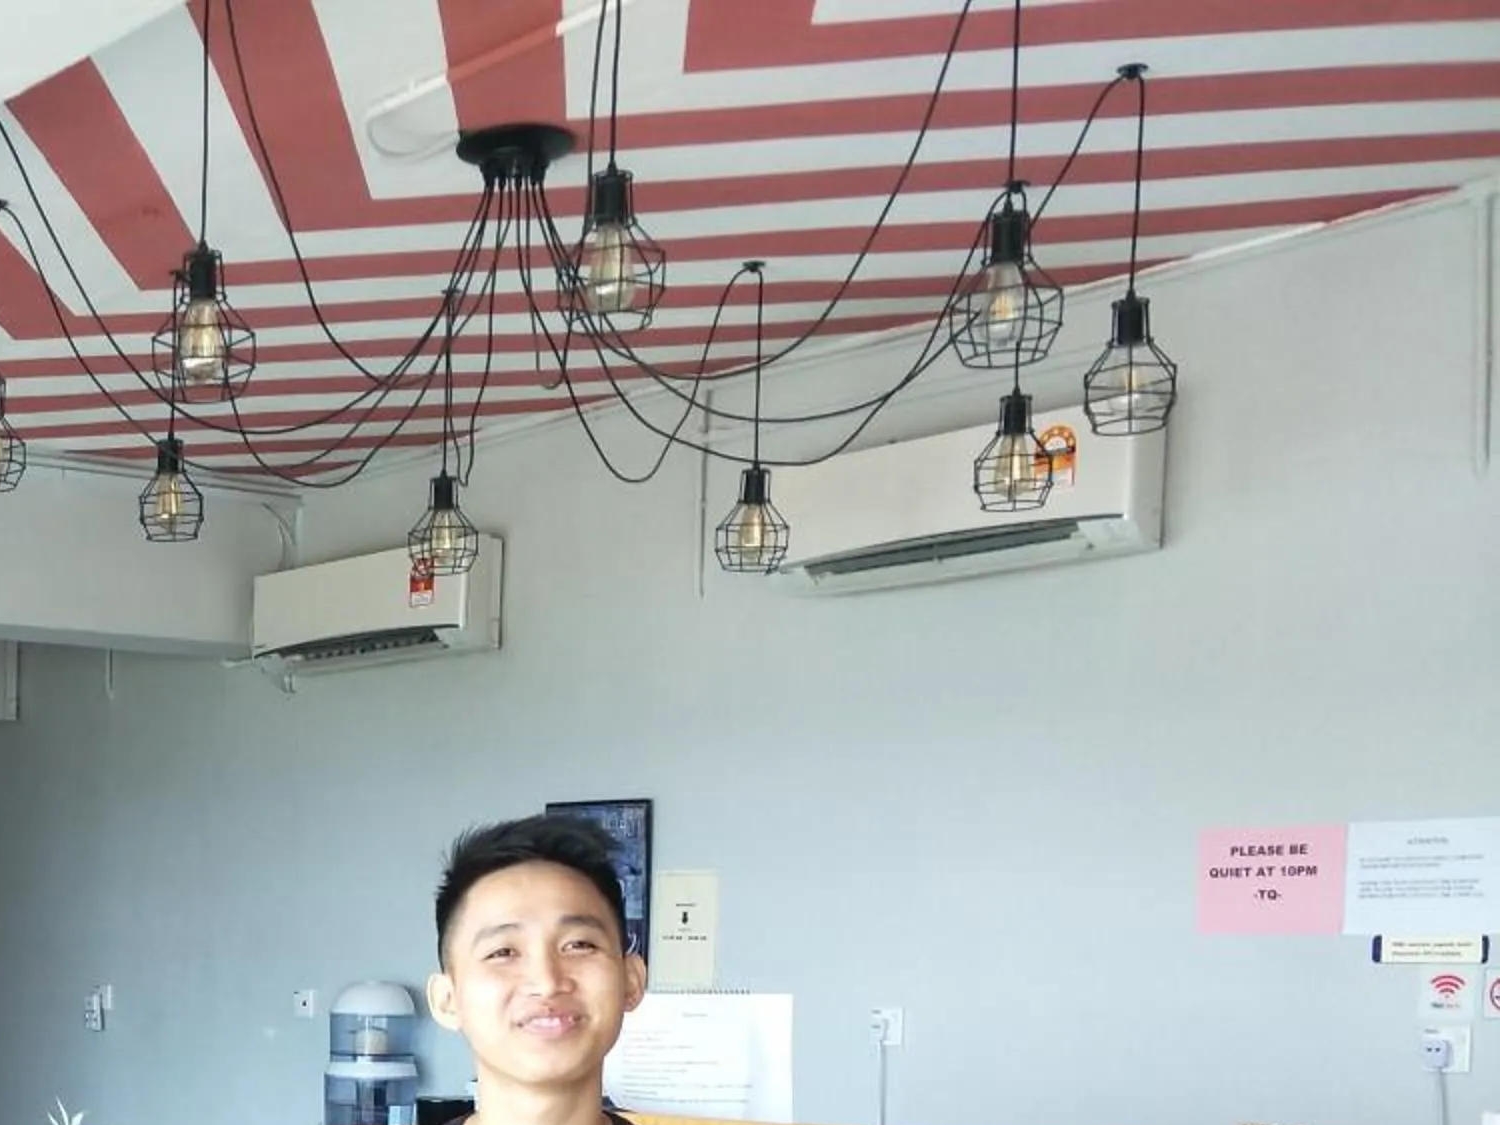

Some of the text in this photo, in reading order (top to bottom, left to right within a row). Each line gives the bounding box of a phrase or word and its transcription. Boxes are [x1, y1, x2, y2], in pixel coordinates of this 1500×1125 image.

[1230, 844, 1309, 857] PLEASE BE
[1209, 864, 1318, 879] QUIET AT 10PM
[1253, 888, 1282, 901] -TQ-
